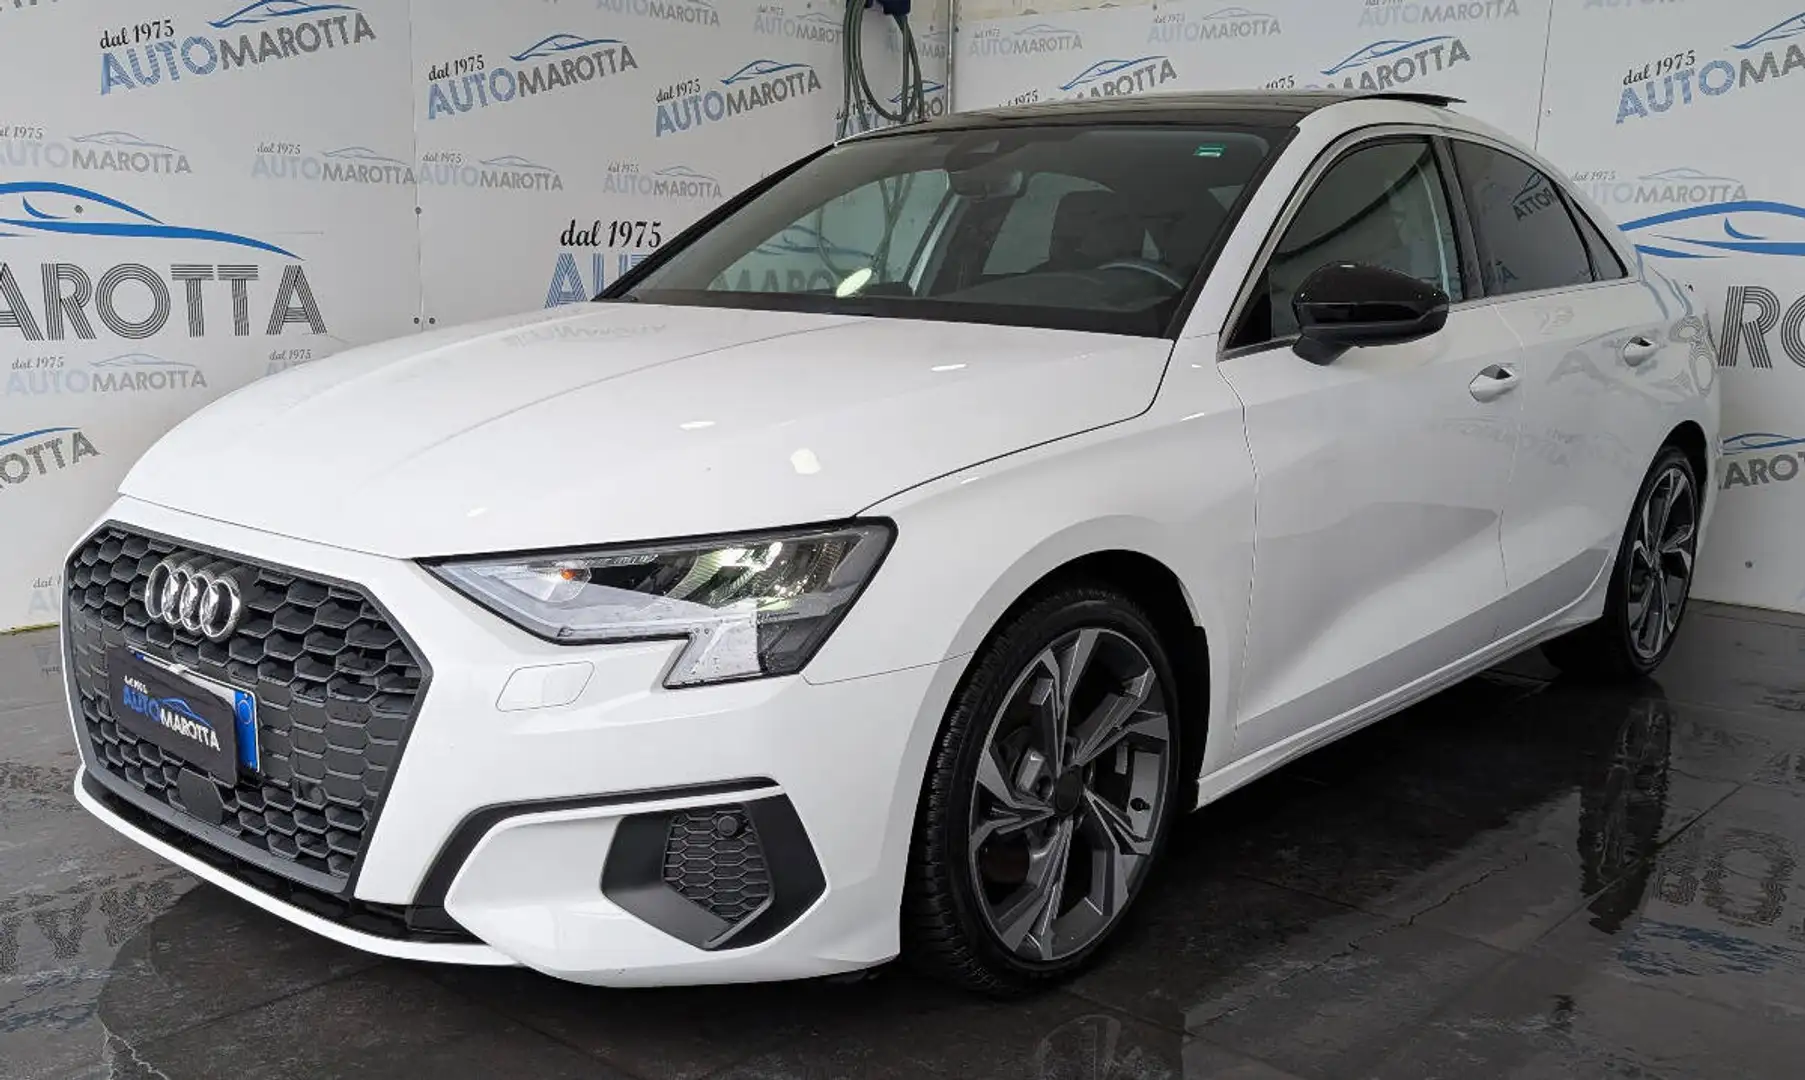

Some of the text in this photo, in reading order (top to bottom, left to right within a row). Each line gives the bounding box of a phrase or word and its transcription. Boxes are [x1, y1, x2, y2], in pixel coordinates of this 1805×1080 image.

[100, 19, 175, 49] dal 1975
[1147, 19, 1281, 44] AUTOMAROTTA
[100, 12, 377, 95] AUTOMAROTTA
[428, 54, 485, 81] dal 1975
[1623, 50, 1696, 86] dal 1975
[428, 45, 638, 120] AUTOMAROTTA
[655, 78, 701, 103] dal 1975
[655, 69, 822, 137] AUTOMAROTTA
[13, 126, 43, 140] 1975
[257, 142, 301, 155] dal 1975
[251, 156, 416, 184] AUTOMAROTTA
[420, 165, 564, 191] AUTOMAROTTA
[1591, 170, 1615, 181] 1975
[603, 173, 723, 199] AUTOMAROTTA
[560, 219, 662, 248] dal 1975
[544, 252, 652, 309] AU
[12, 355, 64, 370] dal 1975
[269, 348, 312, 361] dal 1975
[6, 368, 208, 395] AUTOMAROTTA
[123, 684, 221, 752] AUTOMAROTTA
